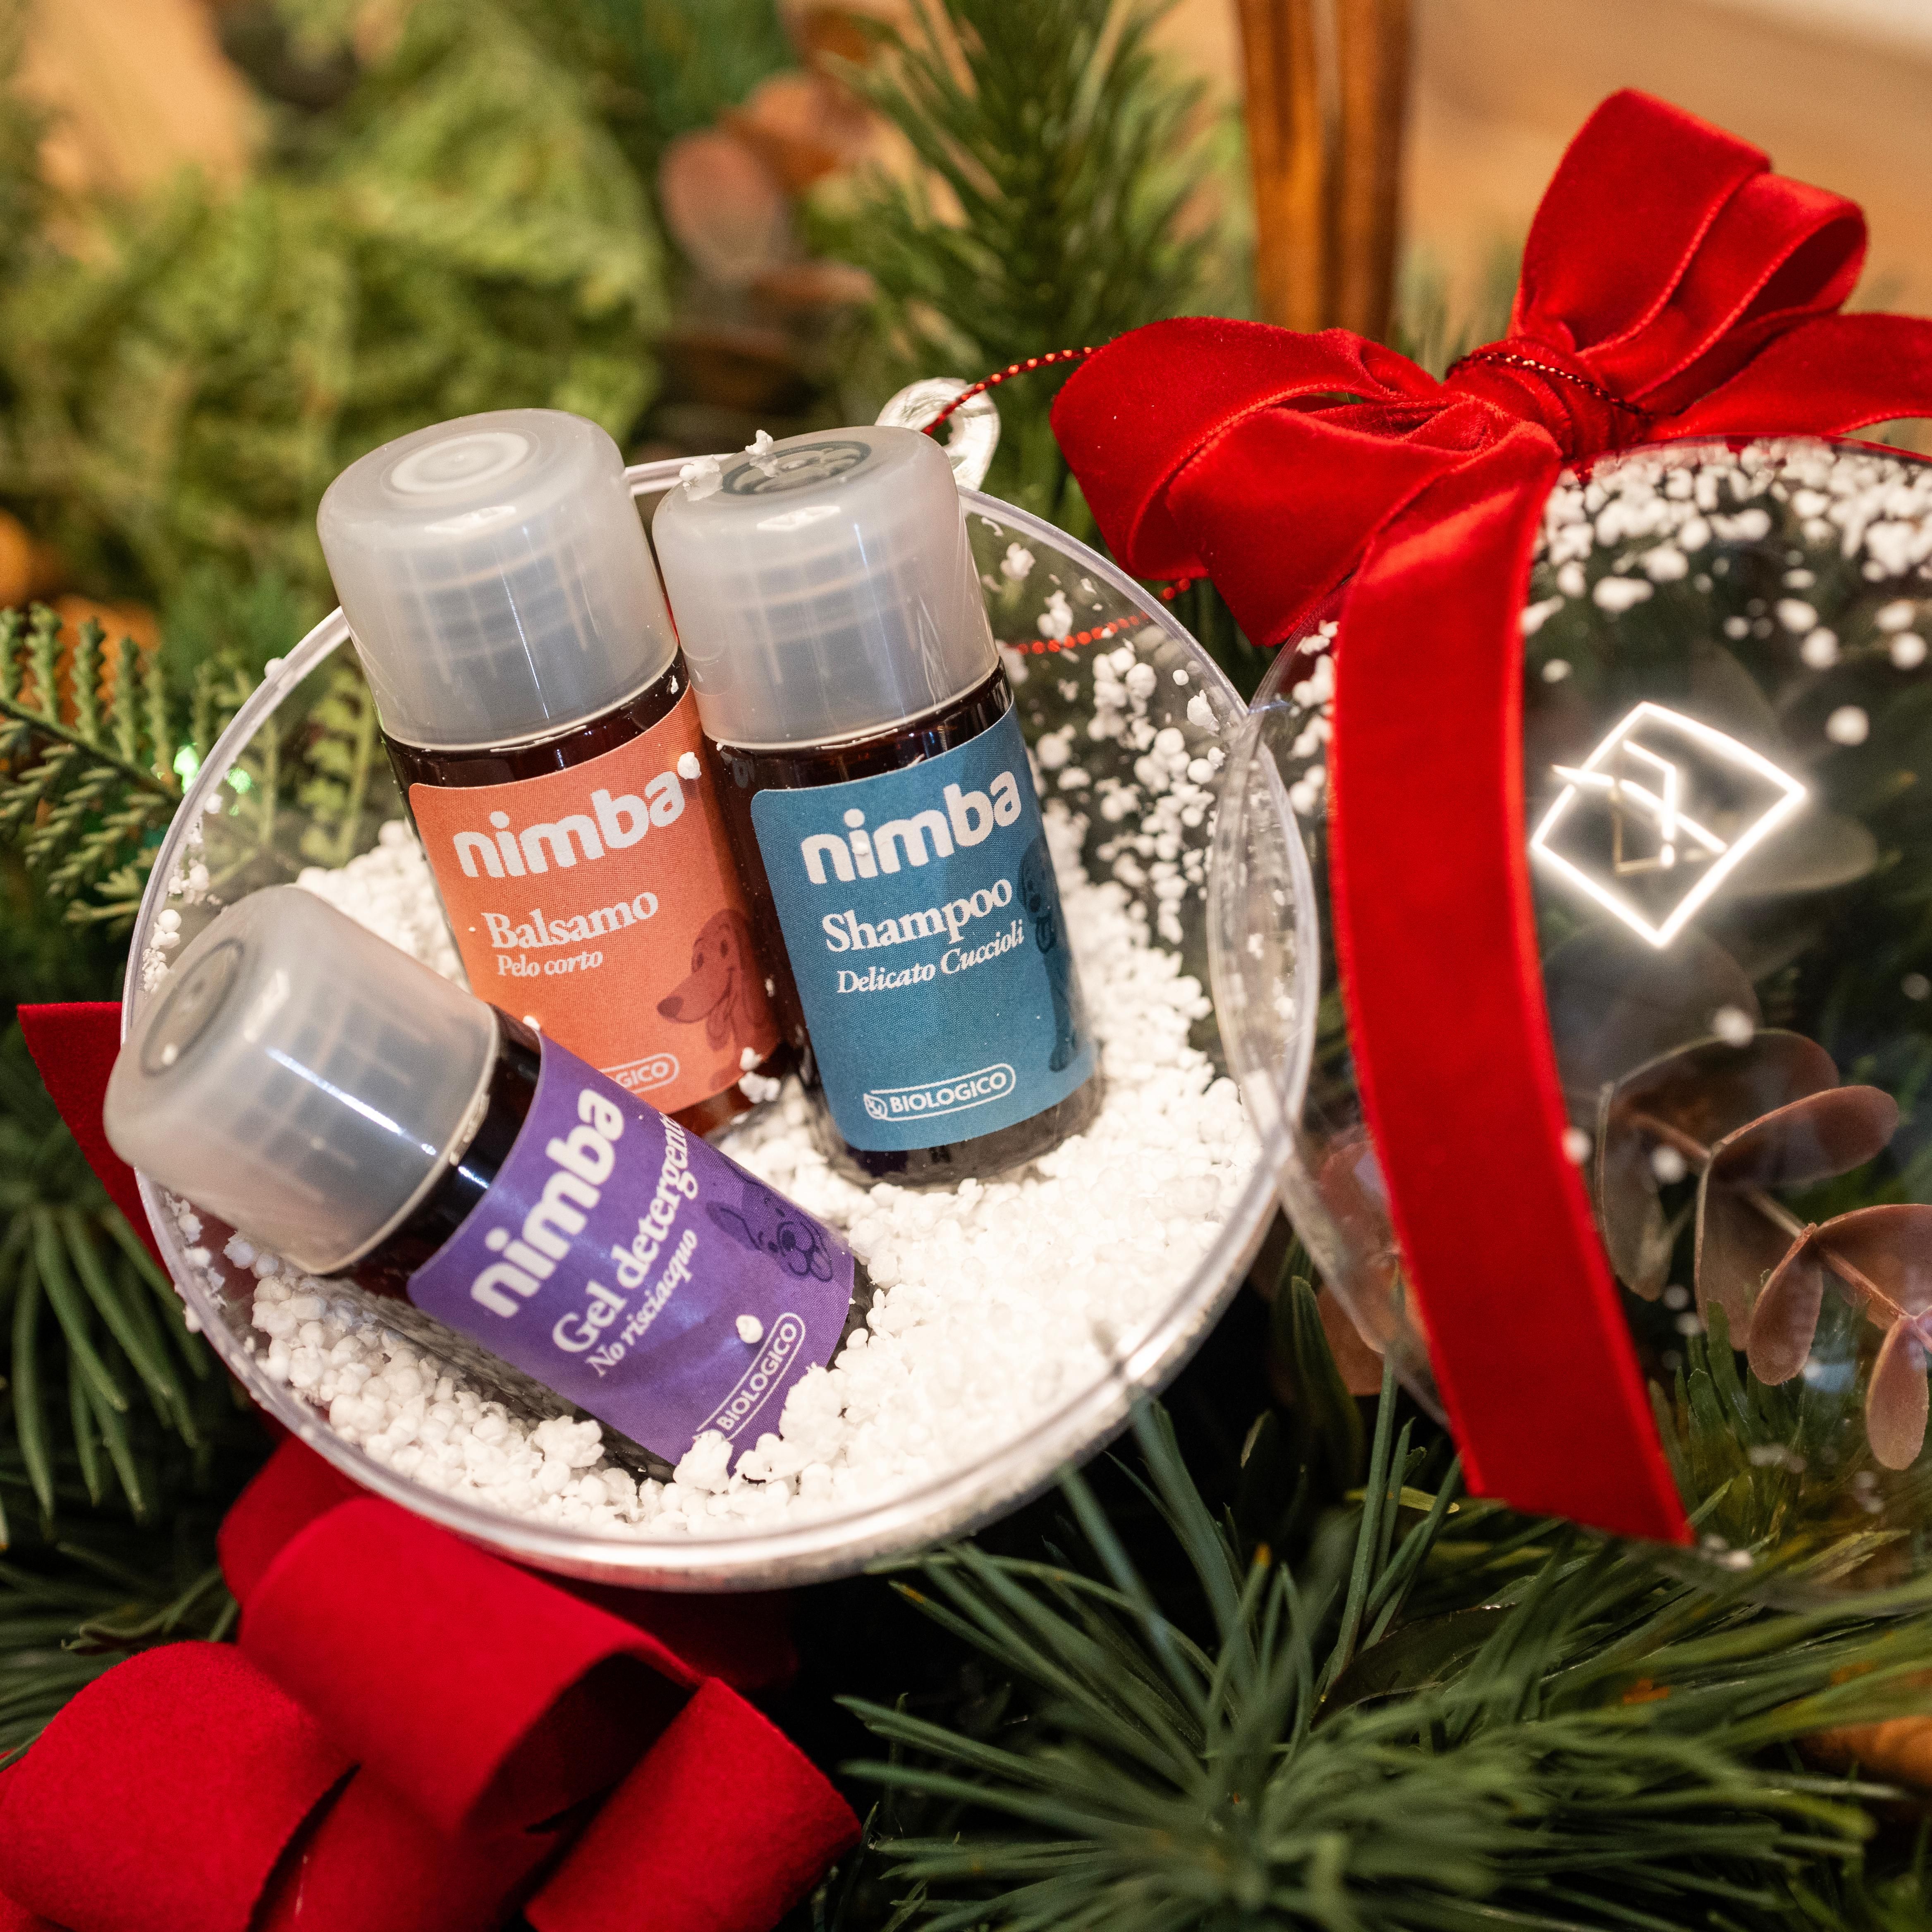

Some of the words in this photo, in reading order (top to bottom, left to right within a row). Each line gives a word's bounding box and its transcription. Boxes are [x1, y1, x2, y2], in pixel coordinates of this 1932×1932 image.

[453, 770, 685, 878] nimba
[801, 771, 1021, 884] nimba
[481, 892, 658, 949] Balsamo
[822, 879, 1012, 952] Shampoo
[497, 954, 541, 977] Pelo
[544, 951, 603, 976] corto
[837, 964, 936, 993] Delicato
[940, 919, 1024, 975] Cuccioli
[889, 1072, 1007, 1113] BIOLOGICO
[471, 1089, 624, 1318] nimba
[552, 1279, 628, 1352] Gel
[585, 1342, 626, 1377] No
[621, 1229, 698, 1346] risciacquo
[716, 1323, 797, 1430] BIOLOGICO
